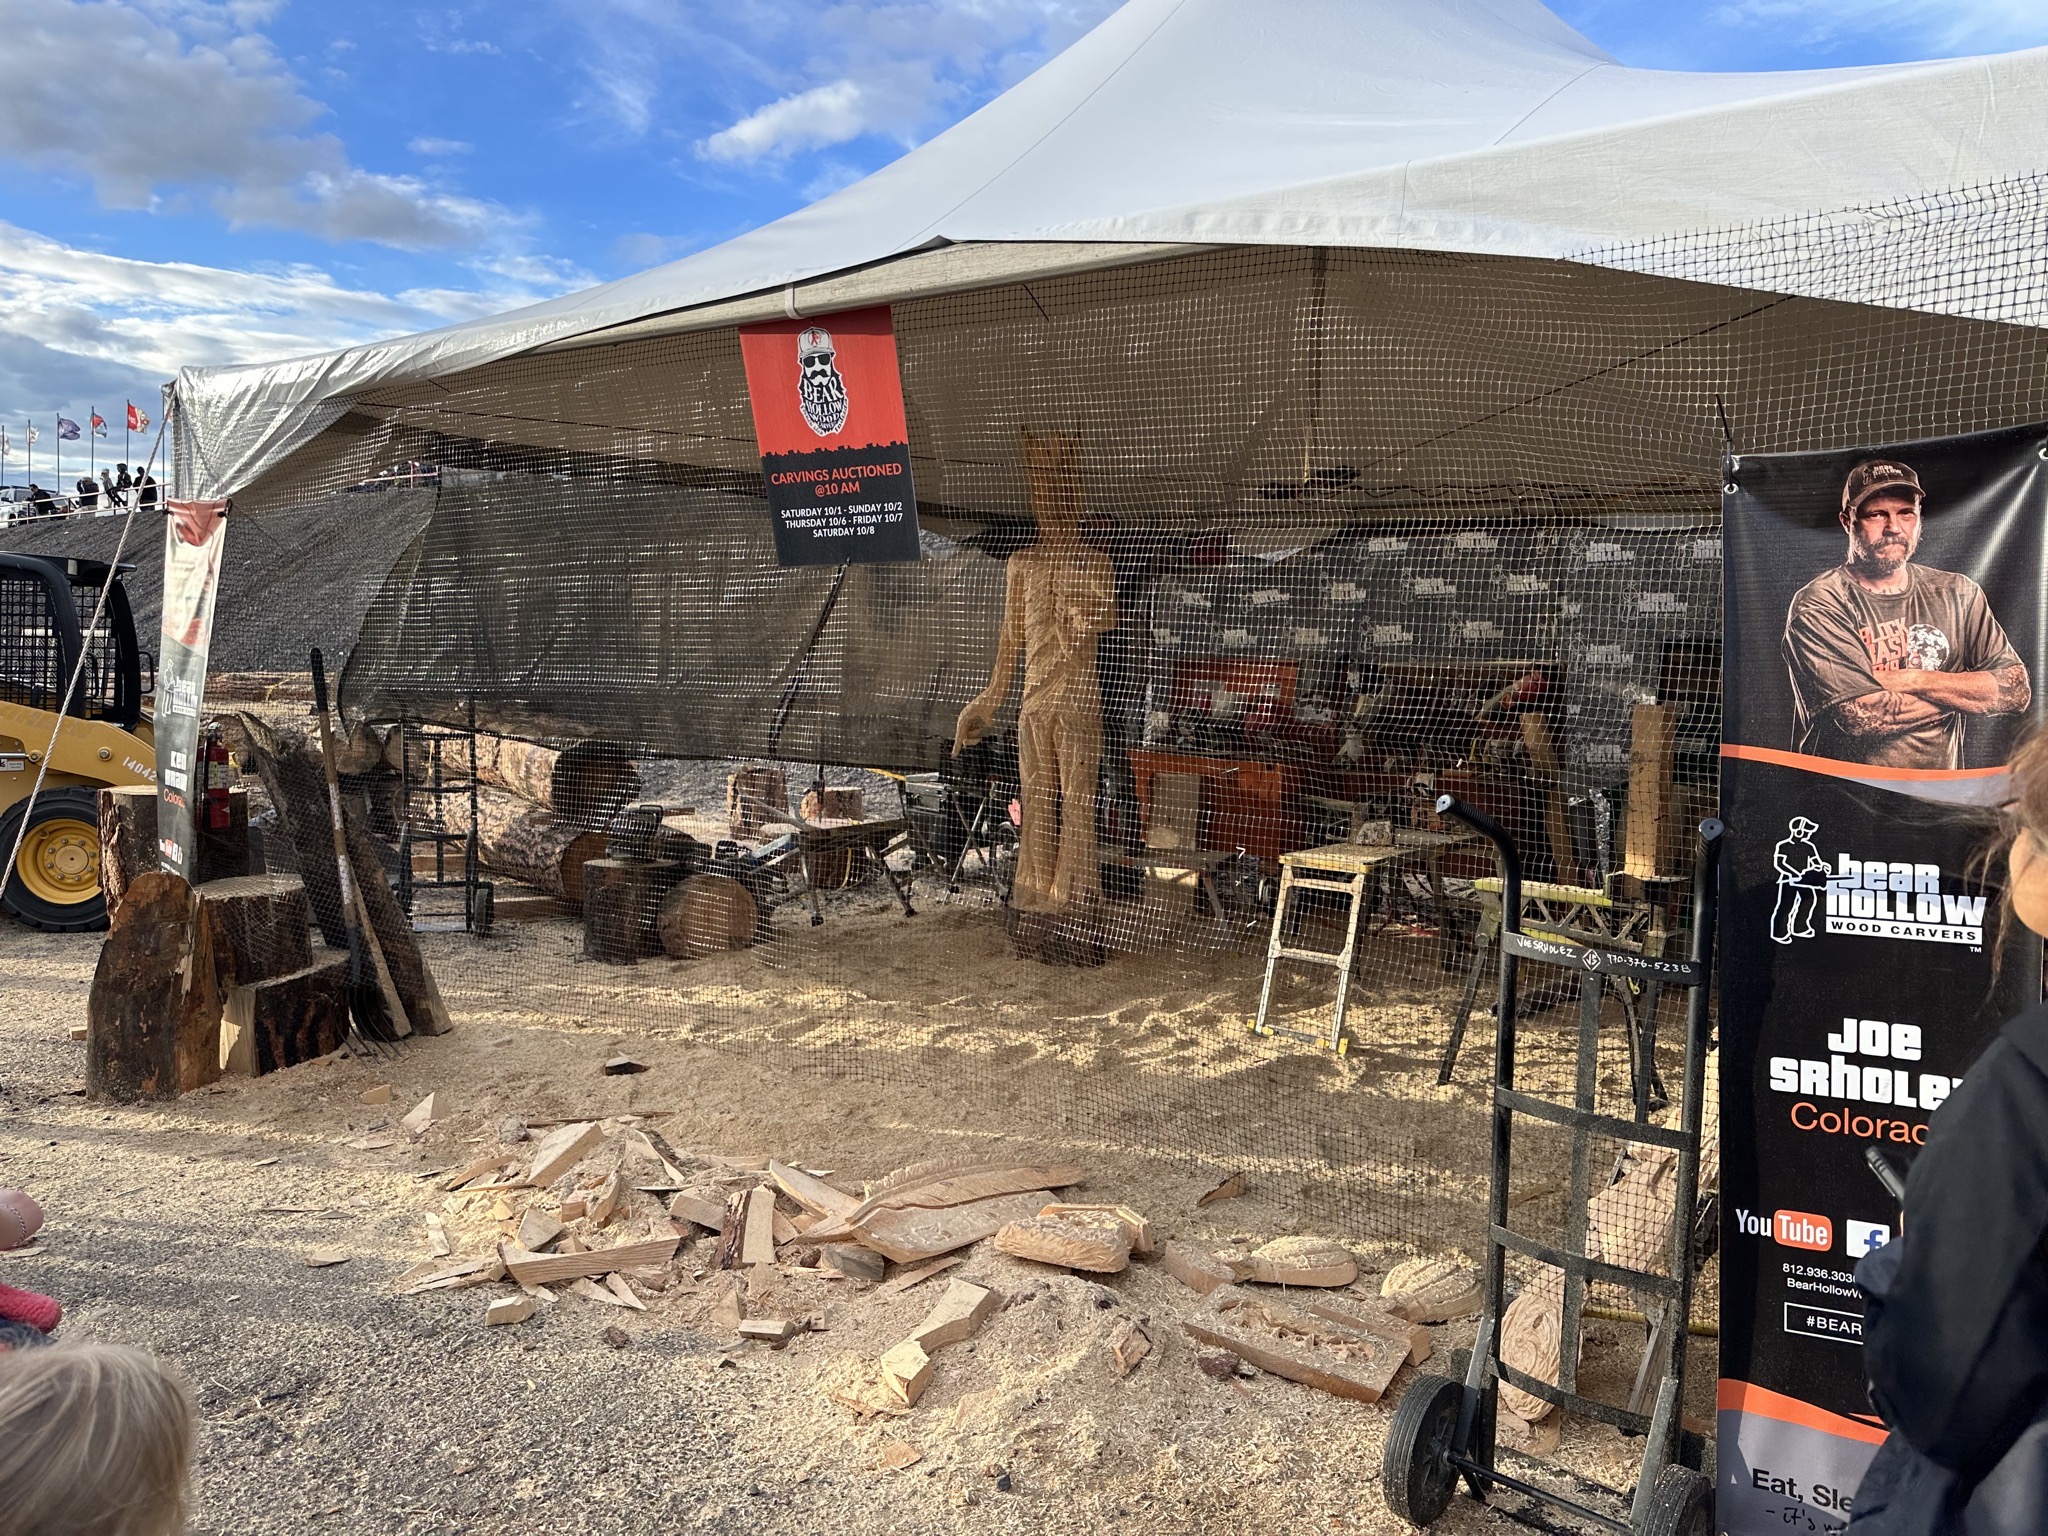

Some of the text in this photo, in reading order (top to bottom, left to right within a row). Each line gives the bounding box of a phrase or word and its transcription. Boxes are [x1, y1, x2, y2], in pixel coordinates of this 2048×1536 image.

[803, 376, 844, 403] BEAR
[805, 399, 843, 416] HOLLOW
[809, 412, 840, 423] WOOD
[771, 462, 902, 485] CARVINGS AUCTIONED
[815, 481, 860, 497] @10 AM
[781, 507, 822, 519] SATURDAY
[824, 505, 842, 517] 10/1
[848, 503, 881, 514] SUNDAY
[884, 501, 903, 512] 10/2
[785, 518, 827, 529] THURSDAY
[829, 516, 847, 527] 10/6
[853, 514, 882, 525] FRIDAY
[885, 512, 903, 523] 10/7
[813, 525, 875, 538] SATURDAY 10/8
[1859, 617, 1909, 645] BLOCK
[1831, 920, 1977, 941] WOOD CARVERS
[1806, 1315, 1862, 1336] #BEAR
[1752, 1467, 1853, 1513] Eat, Sle
